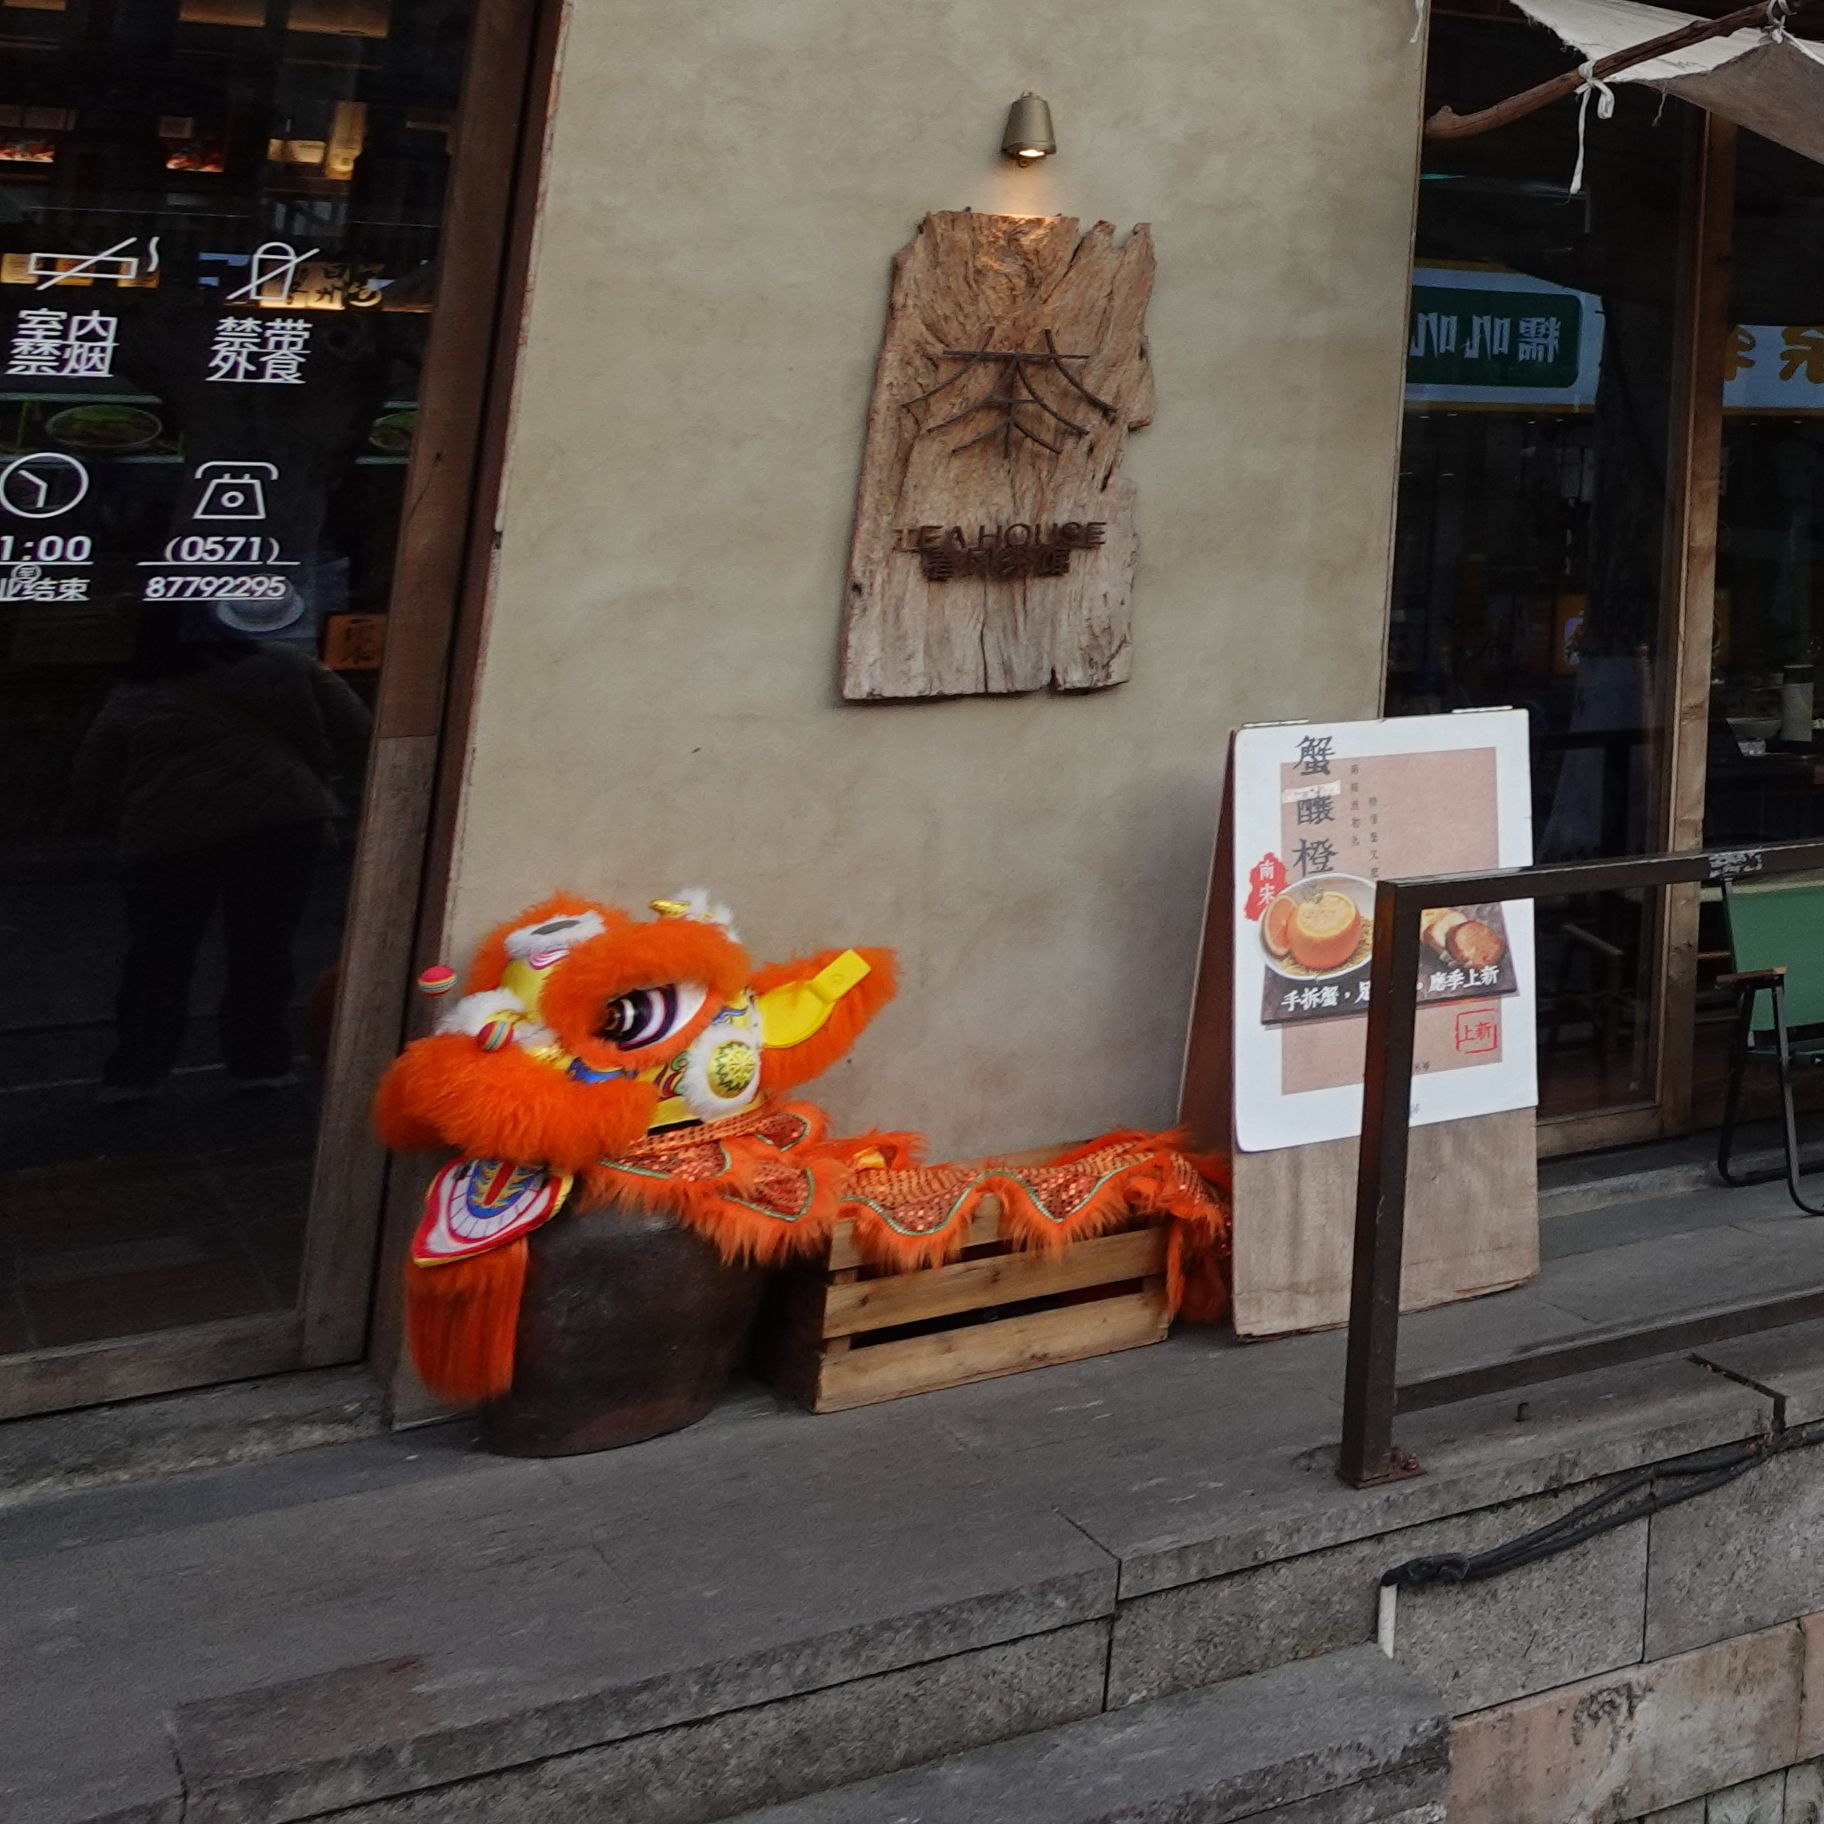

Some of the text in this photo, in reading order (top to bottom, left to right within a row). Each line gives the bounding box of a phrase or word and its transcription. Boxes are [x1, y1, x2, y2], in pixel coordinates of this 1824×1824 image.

[11, 308, 119, 345] 室内
[211, 317, 313, 353] 禁带
[4, 342, 117, 378] 禁烟
[206, 350, 307, 384] 外食
[165, 536, 280, 563] (0571)
[894, 522, 1107, 553] TEA HOUSE
[144, 576, 286, 599] 87792295
